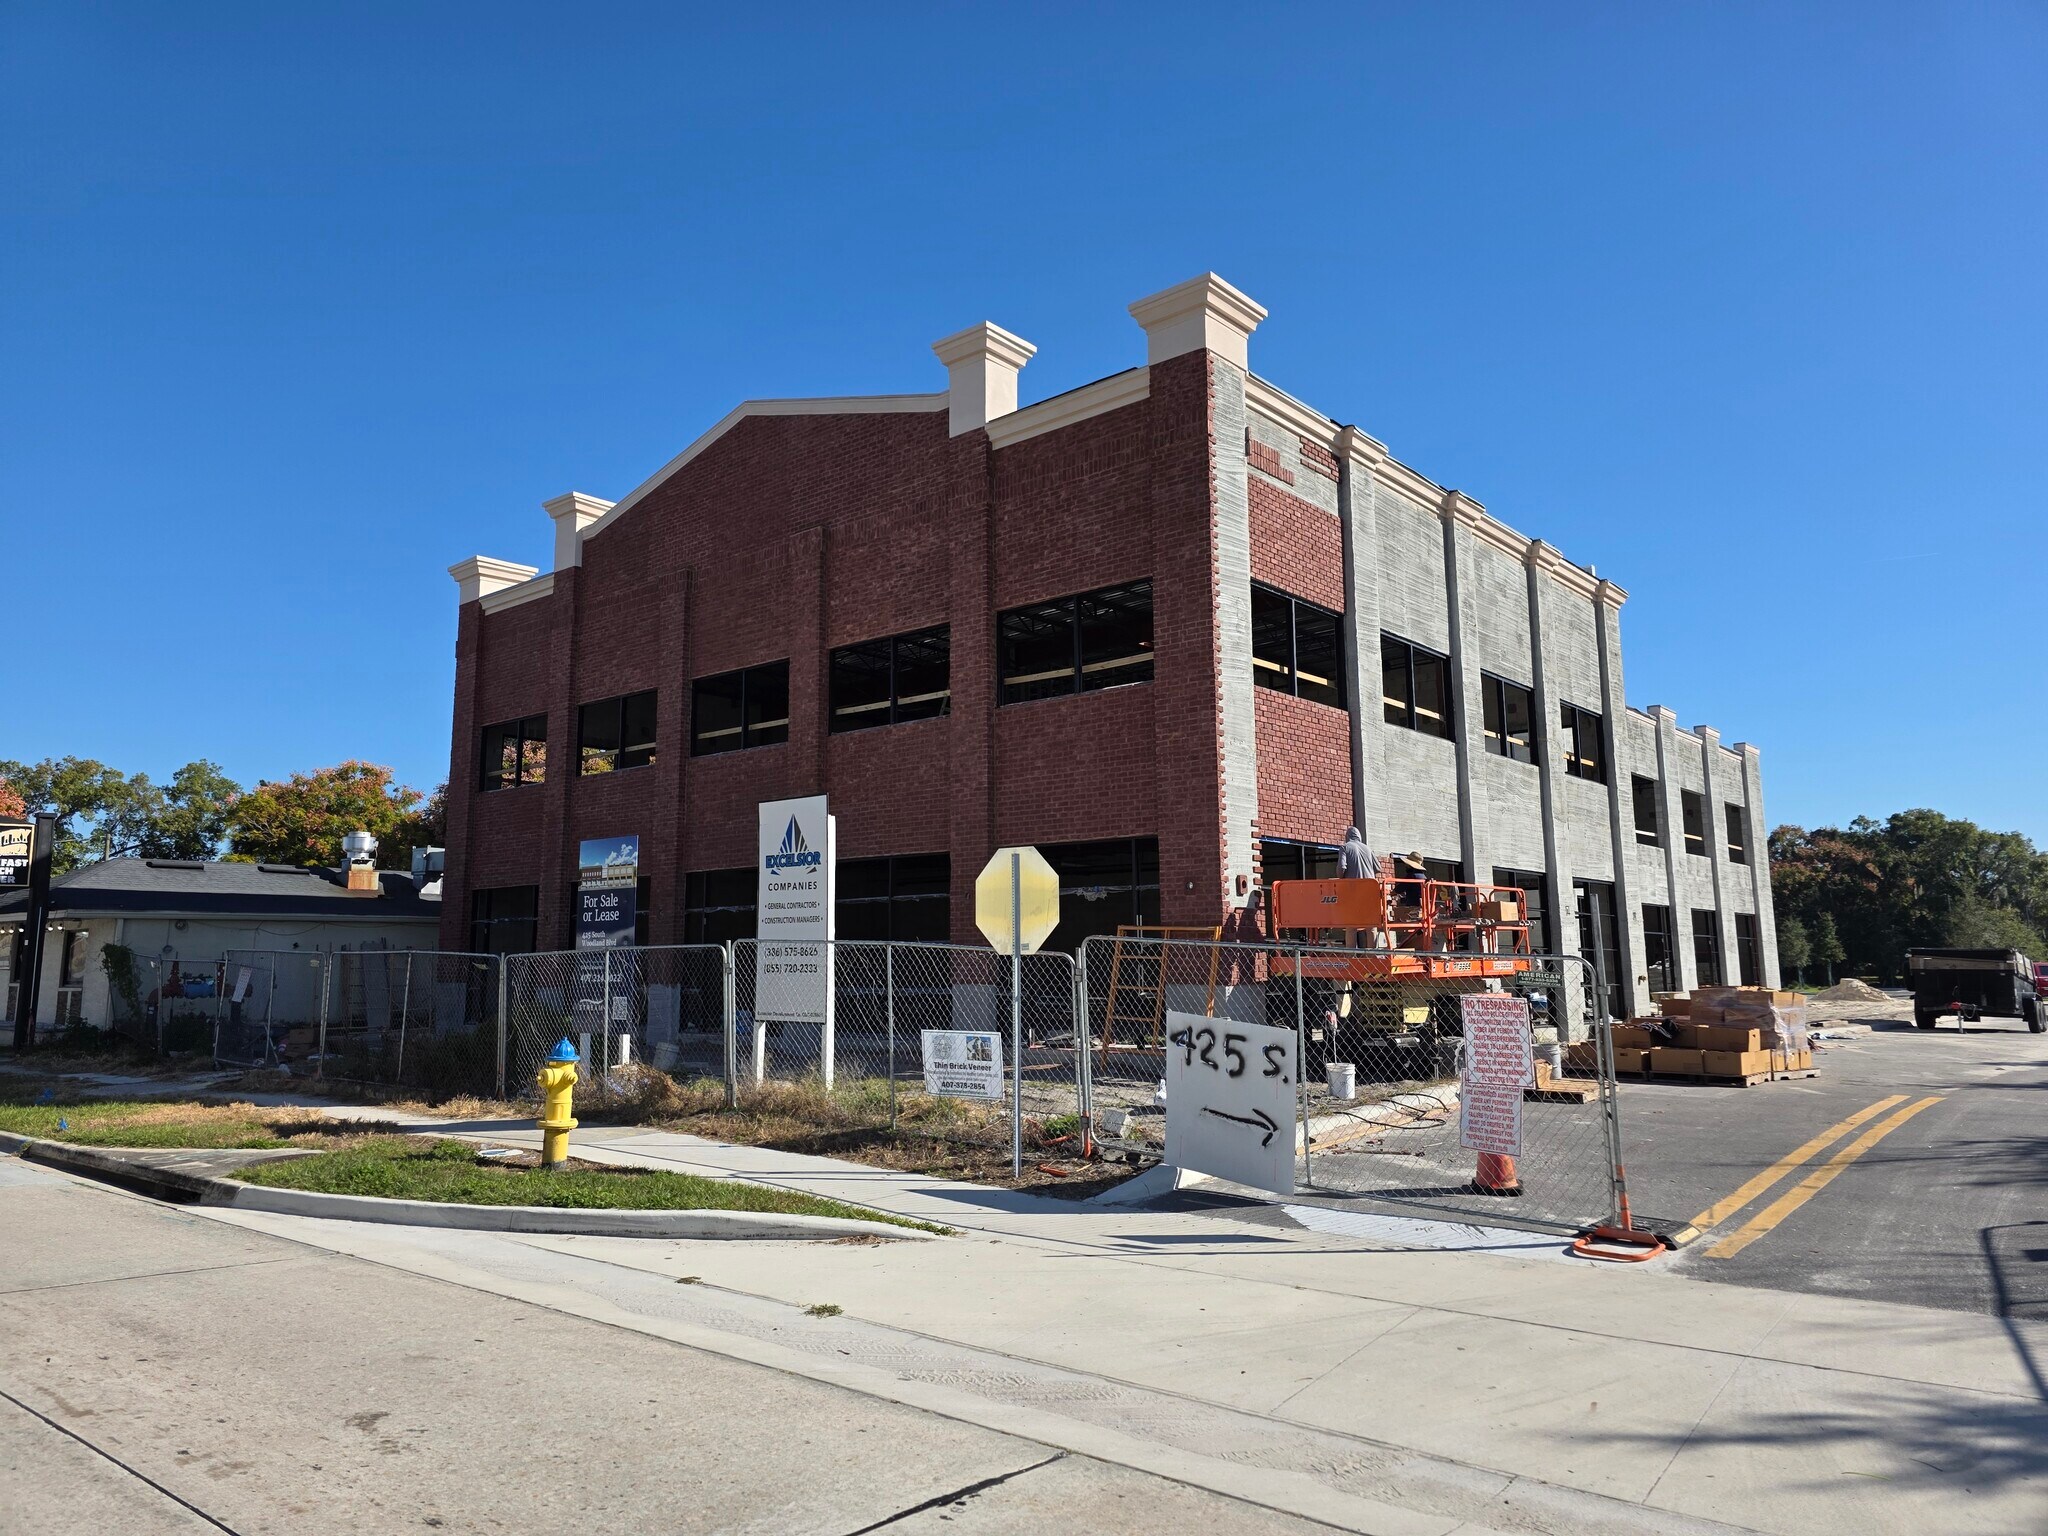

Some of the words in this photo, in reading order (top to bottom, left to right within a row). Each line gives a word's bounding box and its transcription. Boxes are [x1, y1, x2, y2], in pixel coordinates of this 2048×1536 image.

[766, 851, 821, 868] EXCELSIOR
[768, 881, 818, 892] COMPANIES
[583, 895, 598, 908] For
[600, 893, 619, 908] Sale
[787, 901, 817, 909] CONTRACTORS
[583, 911, 593, 922] or
[594, 909, 620, 922] Lease
[581, 932, 591, 940] 425
[592, 930, 605, 938] South
[581, 939, 605, 947] Woodland
[605, 938, 617, 947] Blvd
[1465, 999, 1475, 1009] NO
[1477, 1000, 1524, 1012] TRESPASSING
[1170, 1026, 1247, 1077] 425
[1262, 1044, 1288, 1083] S.
[949, 1062, 967, 1070] Brick
[968, 1063, 992, 1071] Veneer
